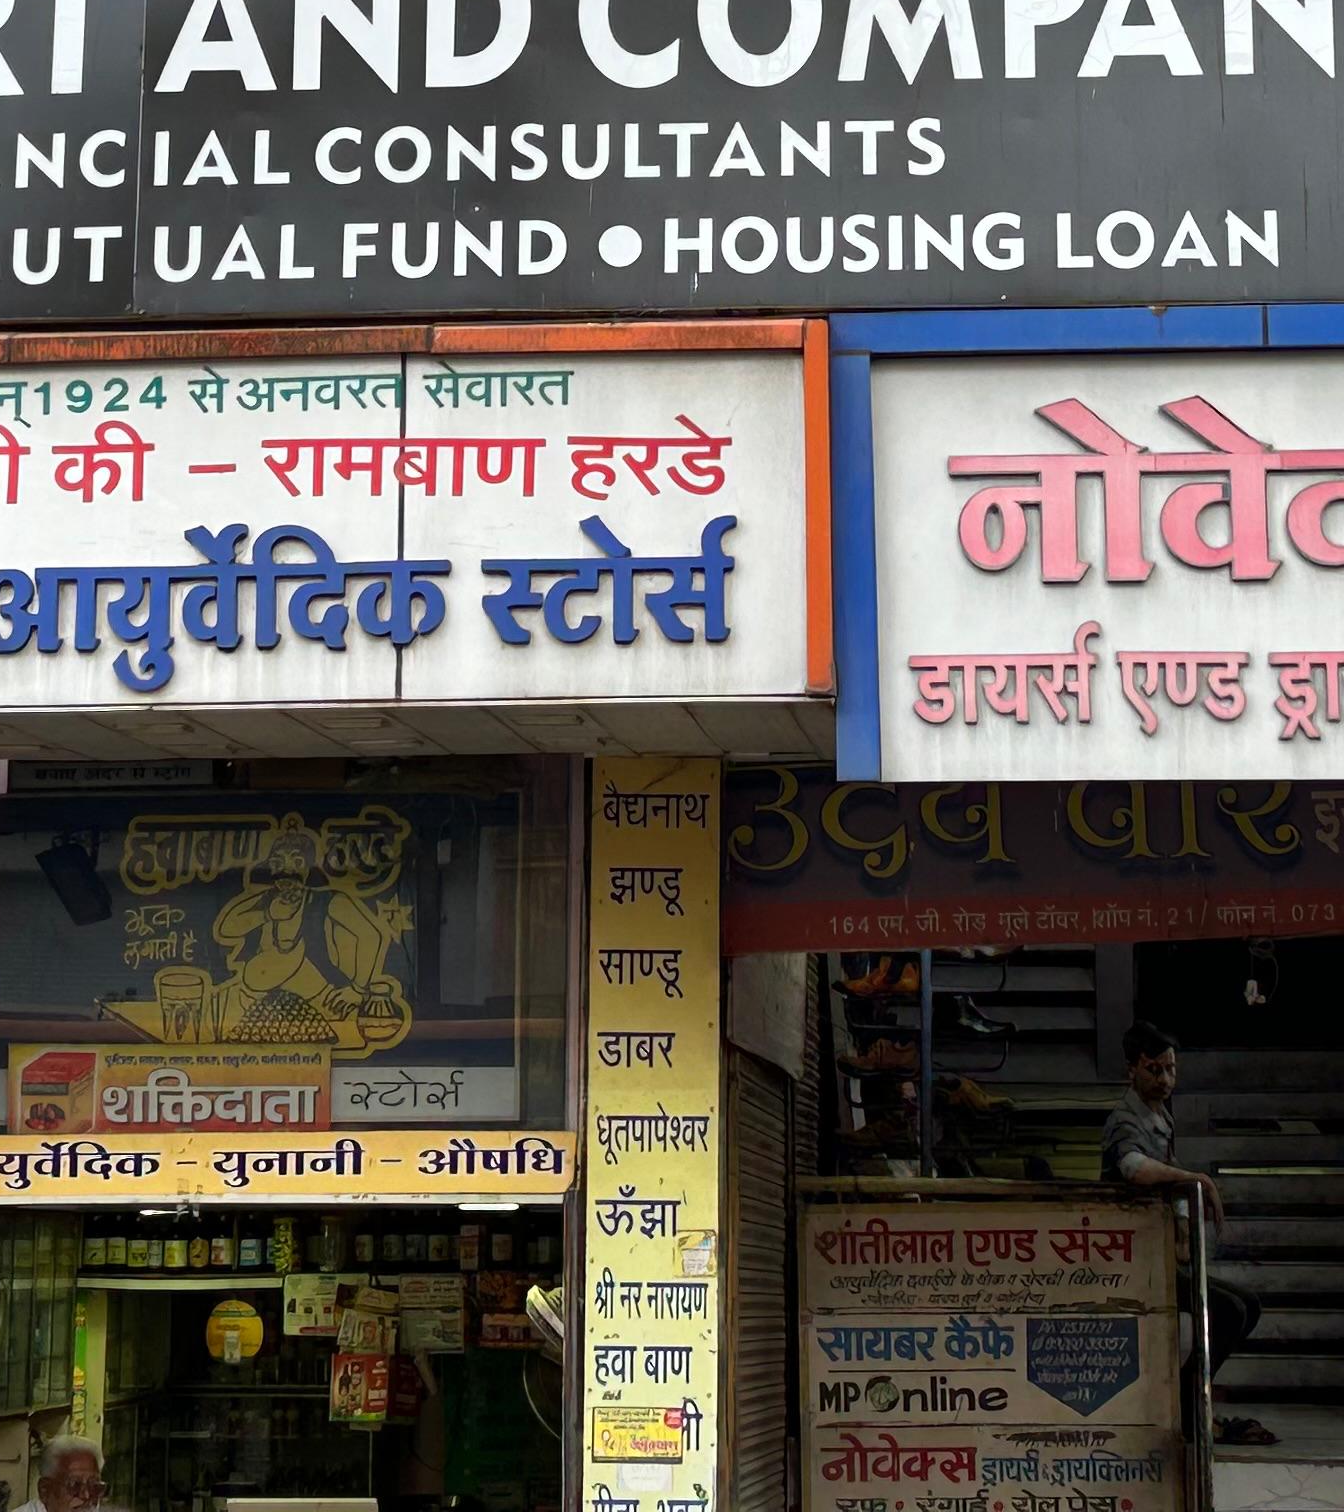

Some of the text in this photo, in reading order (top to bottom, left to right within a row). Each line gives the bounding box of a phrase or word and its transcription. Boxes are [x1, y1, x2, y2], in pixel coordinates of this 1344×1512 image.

[312, 116, 946, 185] CONSULTANTS
[340, 219, 569, 280] FUND
[662, 210, 1025, 277] HOUSING
[1055, 208, 1281, 270] LOAN
[187, 366, 229, 414] से
[233, 373, 407, 414] अनवरत
[423, 361, 574, 409] सेवारत
[53, 419, 156, 504] की
[260, 434, 547, 501] रामबाण
[567, 413, 733, 500] हरडे
[480, 514, 738, 646] स्टोर्स
[908, 619, 1103, 726] डायर्स
[1116, 648, 1251, 737] एण्ड
[609, 867, 686, 917] झण्डू
[598, 949, 685, 999] साण्डू
[597, 1031, 677, 1069] डाबर
[102, 1067, 320, 1125] शक्तिदाता
[344, 1069, 465, 1111] स्टोर्स
[595, 1101, 711, 1166] धूतपापेश्वर
[213, 1138, 365, 1189] युनानी
[418, 1138, 566, 1176] औषधि
[962, 1227, 1039, 1268] एण्ड
[1048, 1215, 1137, 1266] संस
[594, 1265, 710, 1321] श्री नर नारायण
[593, 1343, 694, 1387] हवा बाण
[816, 1325, 939, 1364] सायबर
[820, 1432, 978, 1484] नोवेक्स
